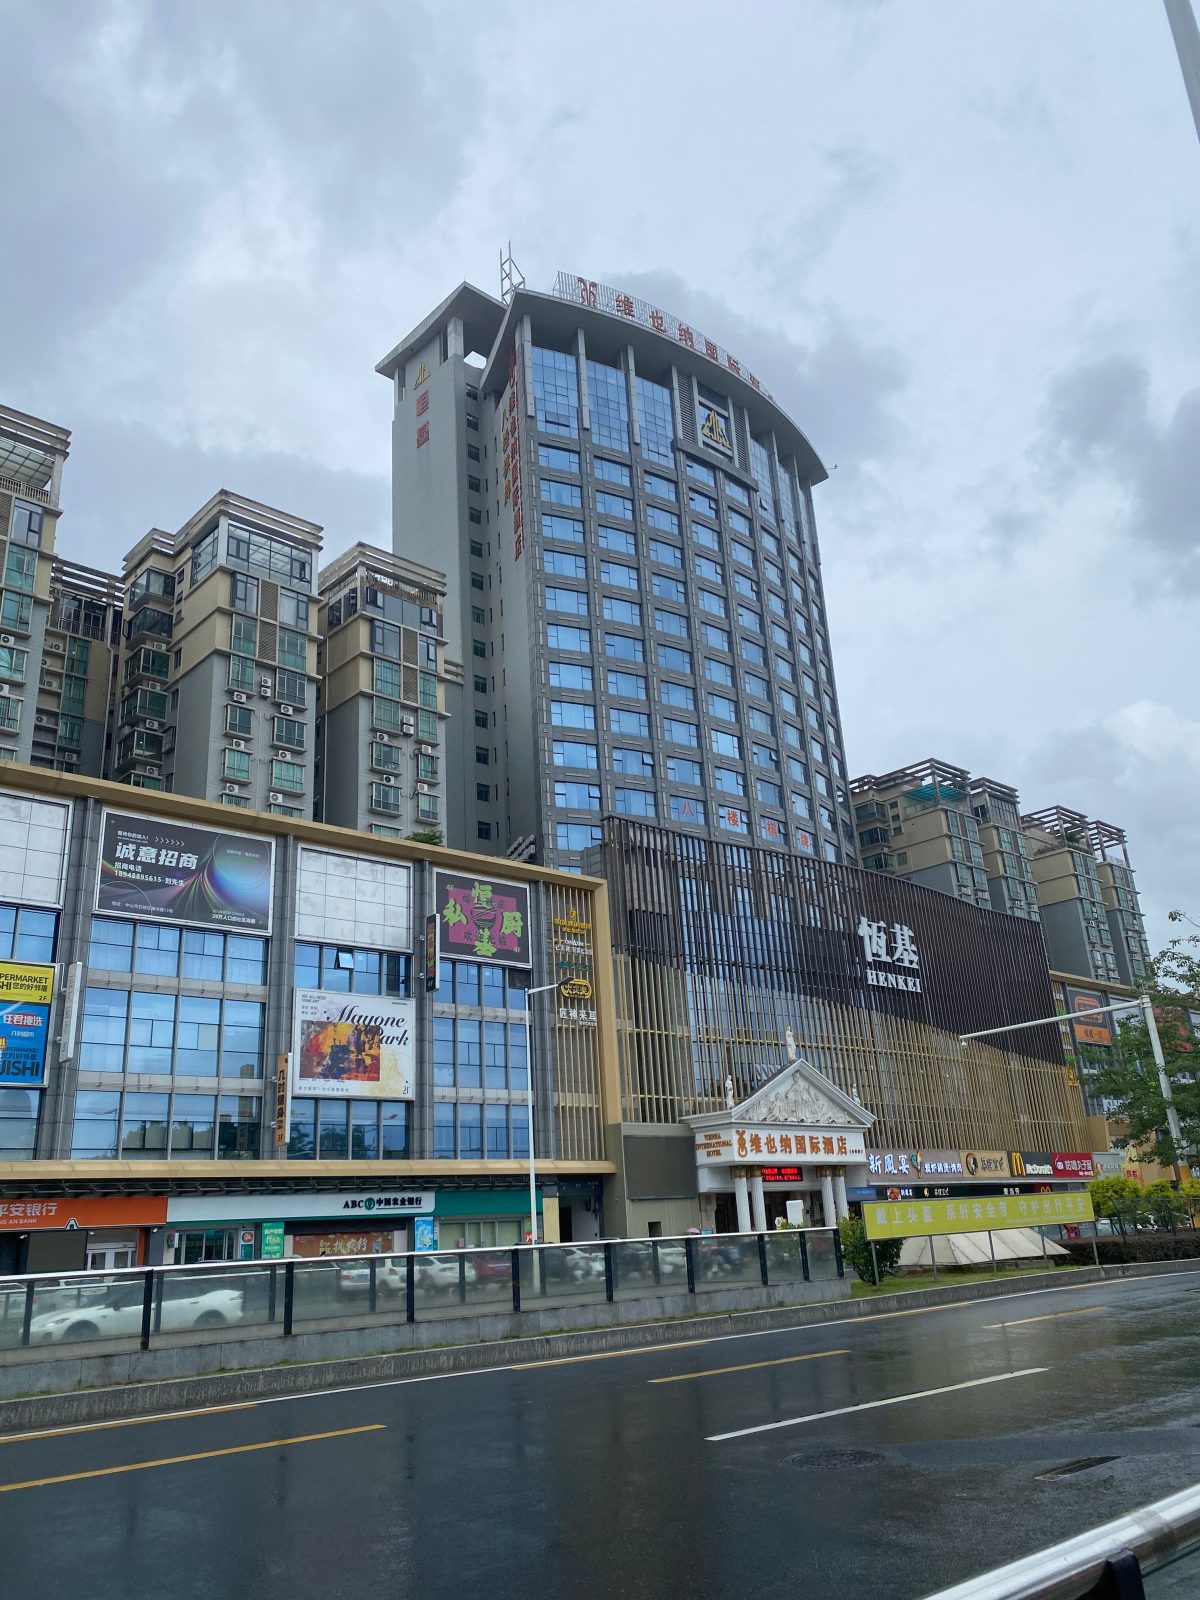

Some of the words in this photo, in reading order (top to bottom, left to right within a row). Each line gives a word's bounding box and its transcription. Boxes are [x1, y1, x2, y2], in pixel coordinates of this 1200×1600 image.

[115, 842, 199, 870] 诚意招商
[115, 862, 142, 872] 招商电话
[115, 870, 162, 882] 18948895615
[165, 877, 185, 887] 刘先生
[865, 969, 922, 993] HENKEI
[13, 983, 48, 993] 您的好邻居
[750, 1133, 848, 1156] 维也纳国际酒店
[1025, 1163, 1053, 1175] McDonald's
[343, 1200, 364, 1209] ABC
[376, 1196, 422, 1206] 中国农业银行
[0, 1203, 57, 1216] 平安银行
[875, 1205, 934, 1226] 戴上头盔
[946, 1200, 1008, 1221] 系好安全带
